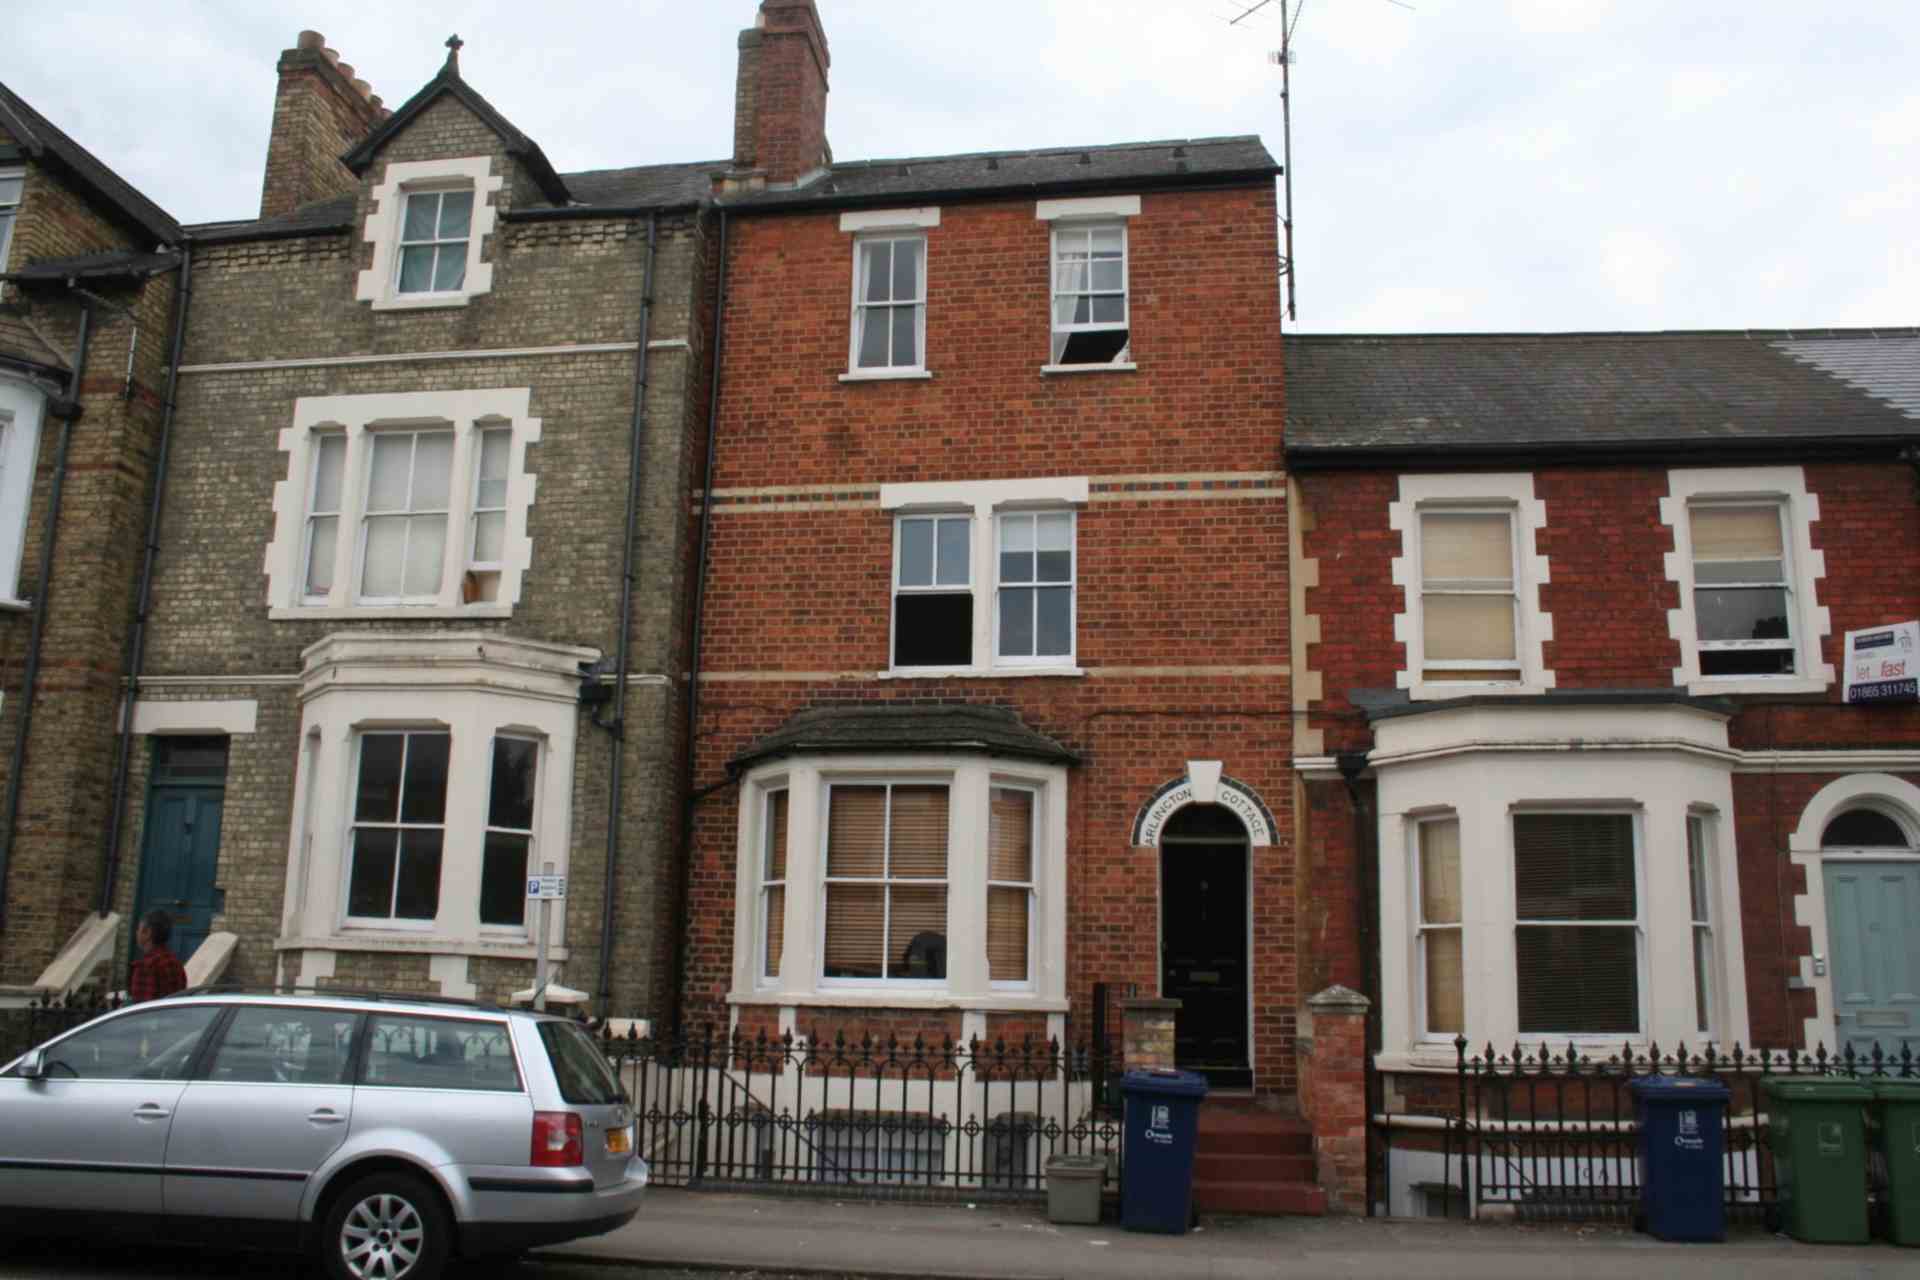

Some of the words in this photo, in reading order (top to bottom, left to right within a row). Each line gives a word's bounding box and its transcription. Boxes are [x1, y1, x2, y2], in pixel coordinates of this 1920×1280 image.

[1881, 660, 1905, 678] fast
[1145, 789, 1192, 846] ARLINGTON
[1221, 791, 1265, 837] COTTAGE
